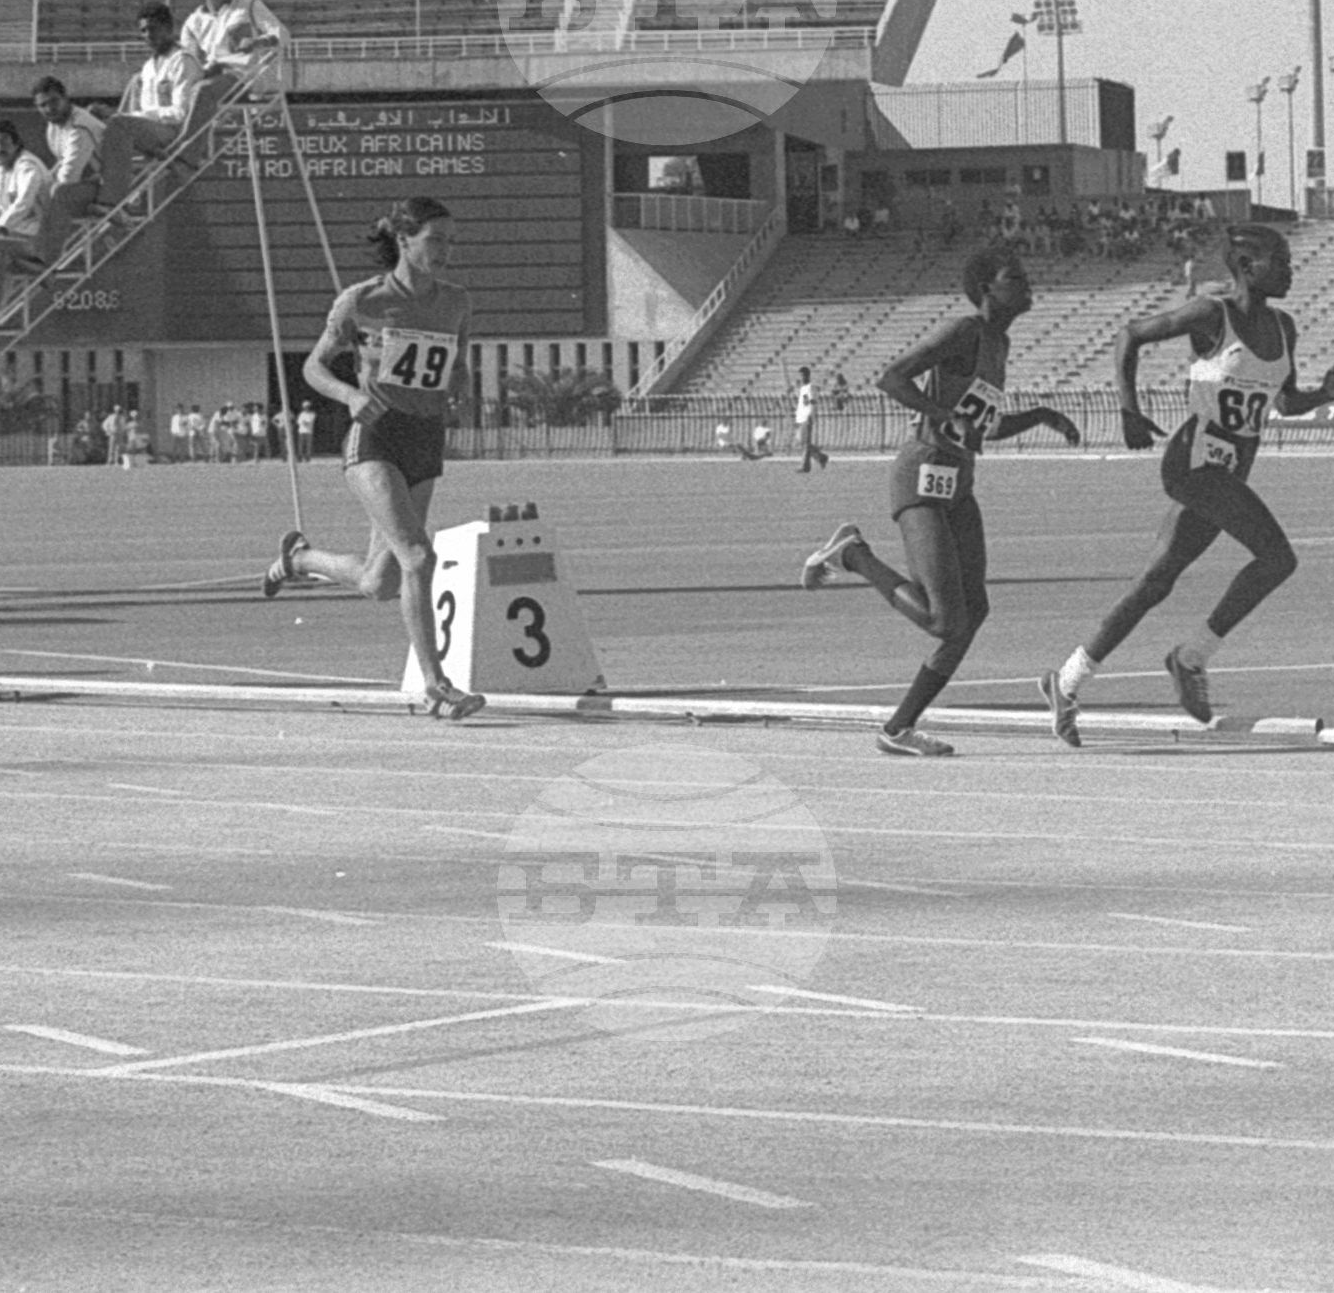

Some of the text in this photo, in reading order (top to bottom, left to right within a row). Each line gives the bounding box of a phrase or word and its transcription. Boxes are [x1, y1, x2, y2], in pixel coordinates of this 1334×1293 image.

[361, 133, 485, 153] AFRICAINS
[307, 159, 403, 177] AFRICAN
[417, 156, 485, 176] GAMES
[391, 343, 449, 388] 49
[1218, 388, 1269, 432] 60
[437, 590, 456, 661] 3
[507, 596, 551, 668] 3
